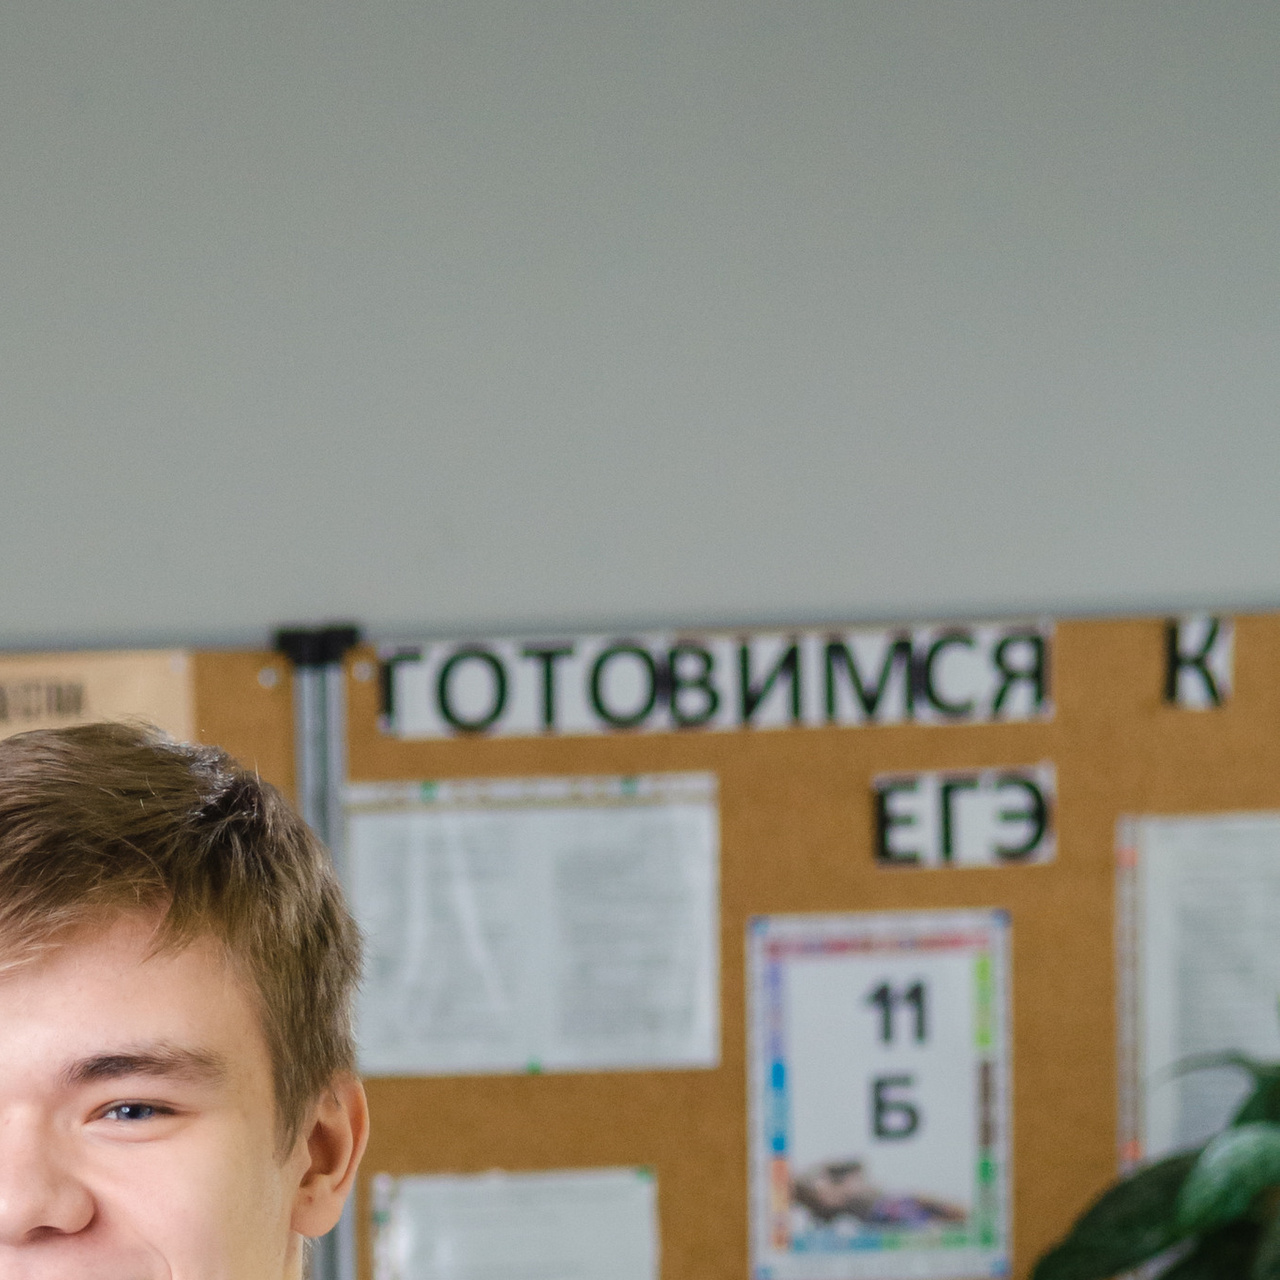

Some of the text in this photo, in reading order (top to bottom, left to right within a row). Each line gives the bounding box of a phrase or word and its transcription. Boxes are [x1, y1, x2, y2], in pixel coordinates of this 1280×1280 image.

[380, 616, 1227, 733] ГОТОВИМСЯ К
[874, 775, 1051, 866] ЕГЭ
[867, 977, 930, 1046] 11
[873, 1074, 921, 1142] Б
